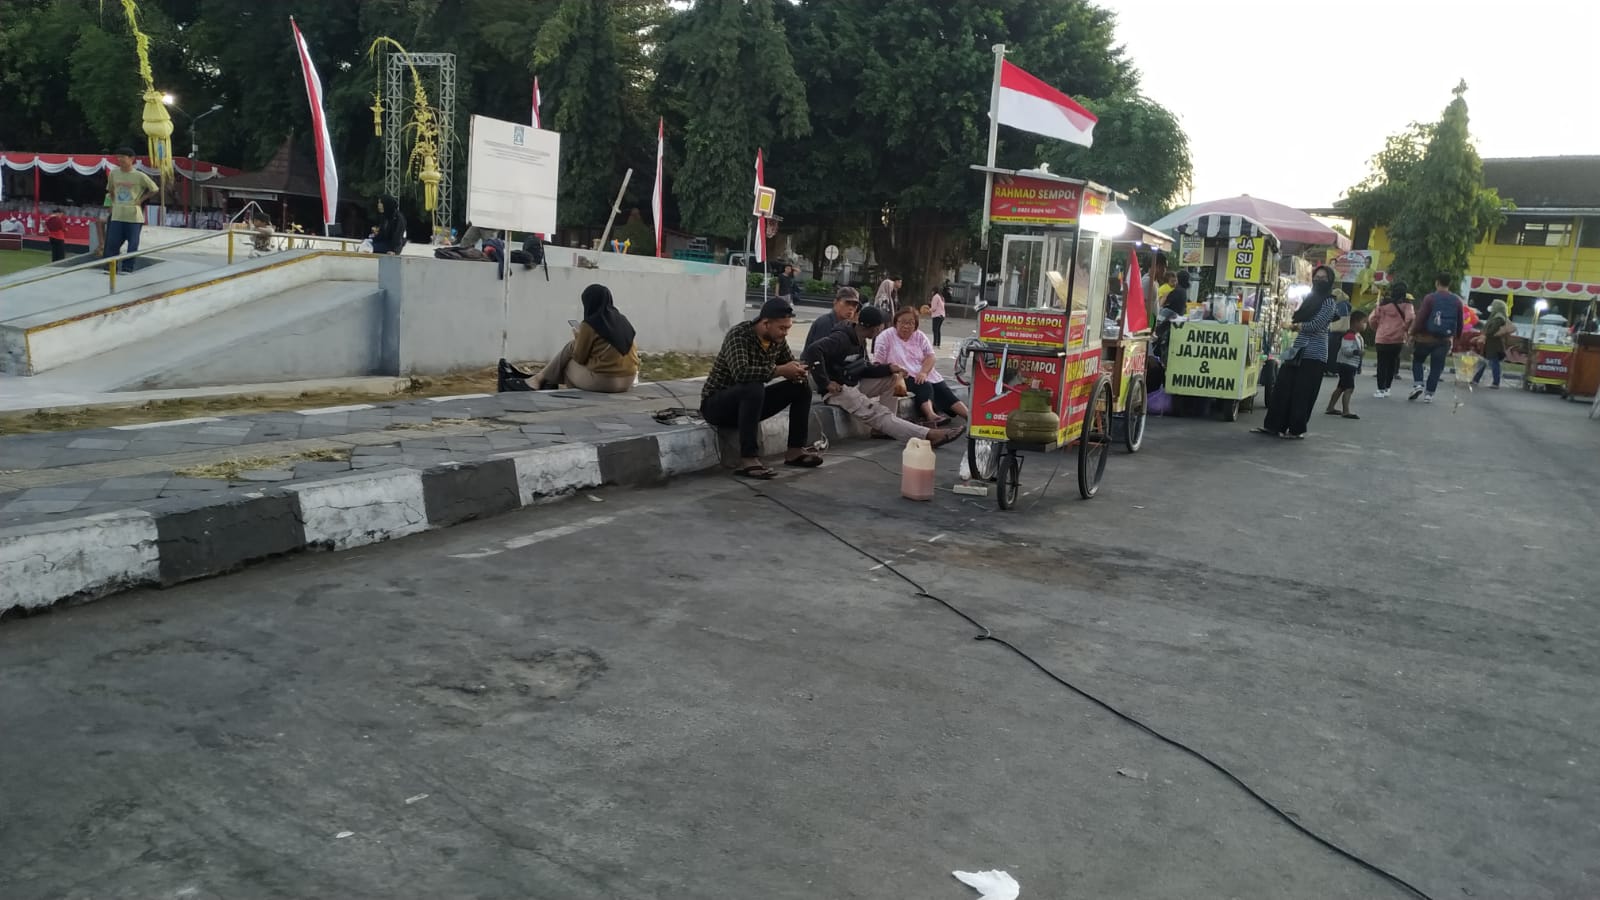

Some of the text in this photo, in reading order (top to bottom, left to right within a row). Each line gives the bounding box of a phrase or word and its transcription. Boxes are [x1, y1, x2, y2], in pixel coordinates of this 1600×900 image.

[994, 187, 1076, 200] RAHMAD SEMPOL
[1238, 237, 1255, 250] JA
[1236, 252, 1253, 264] SU
[1235, 266, 1251, 279] KE
[983, 313, 1024, 325] RAHMAD
[1025, 316, 1063, 328] SEMPOL
[1186, 329, 1230, 345] ANEKA
[1175, 343, 1238, 361] JAJANAN
[1020, 360, 1057, 375] SEMPOL
[1199, 360, 1210, 374] &
[1171, 373, 1235, 391] MINUMAN
